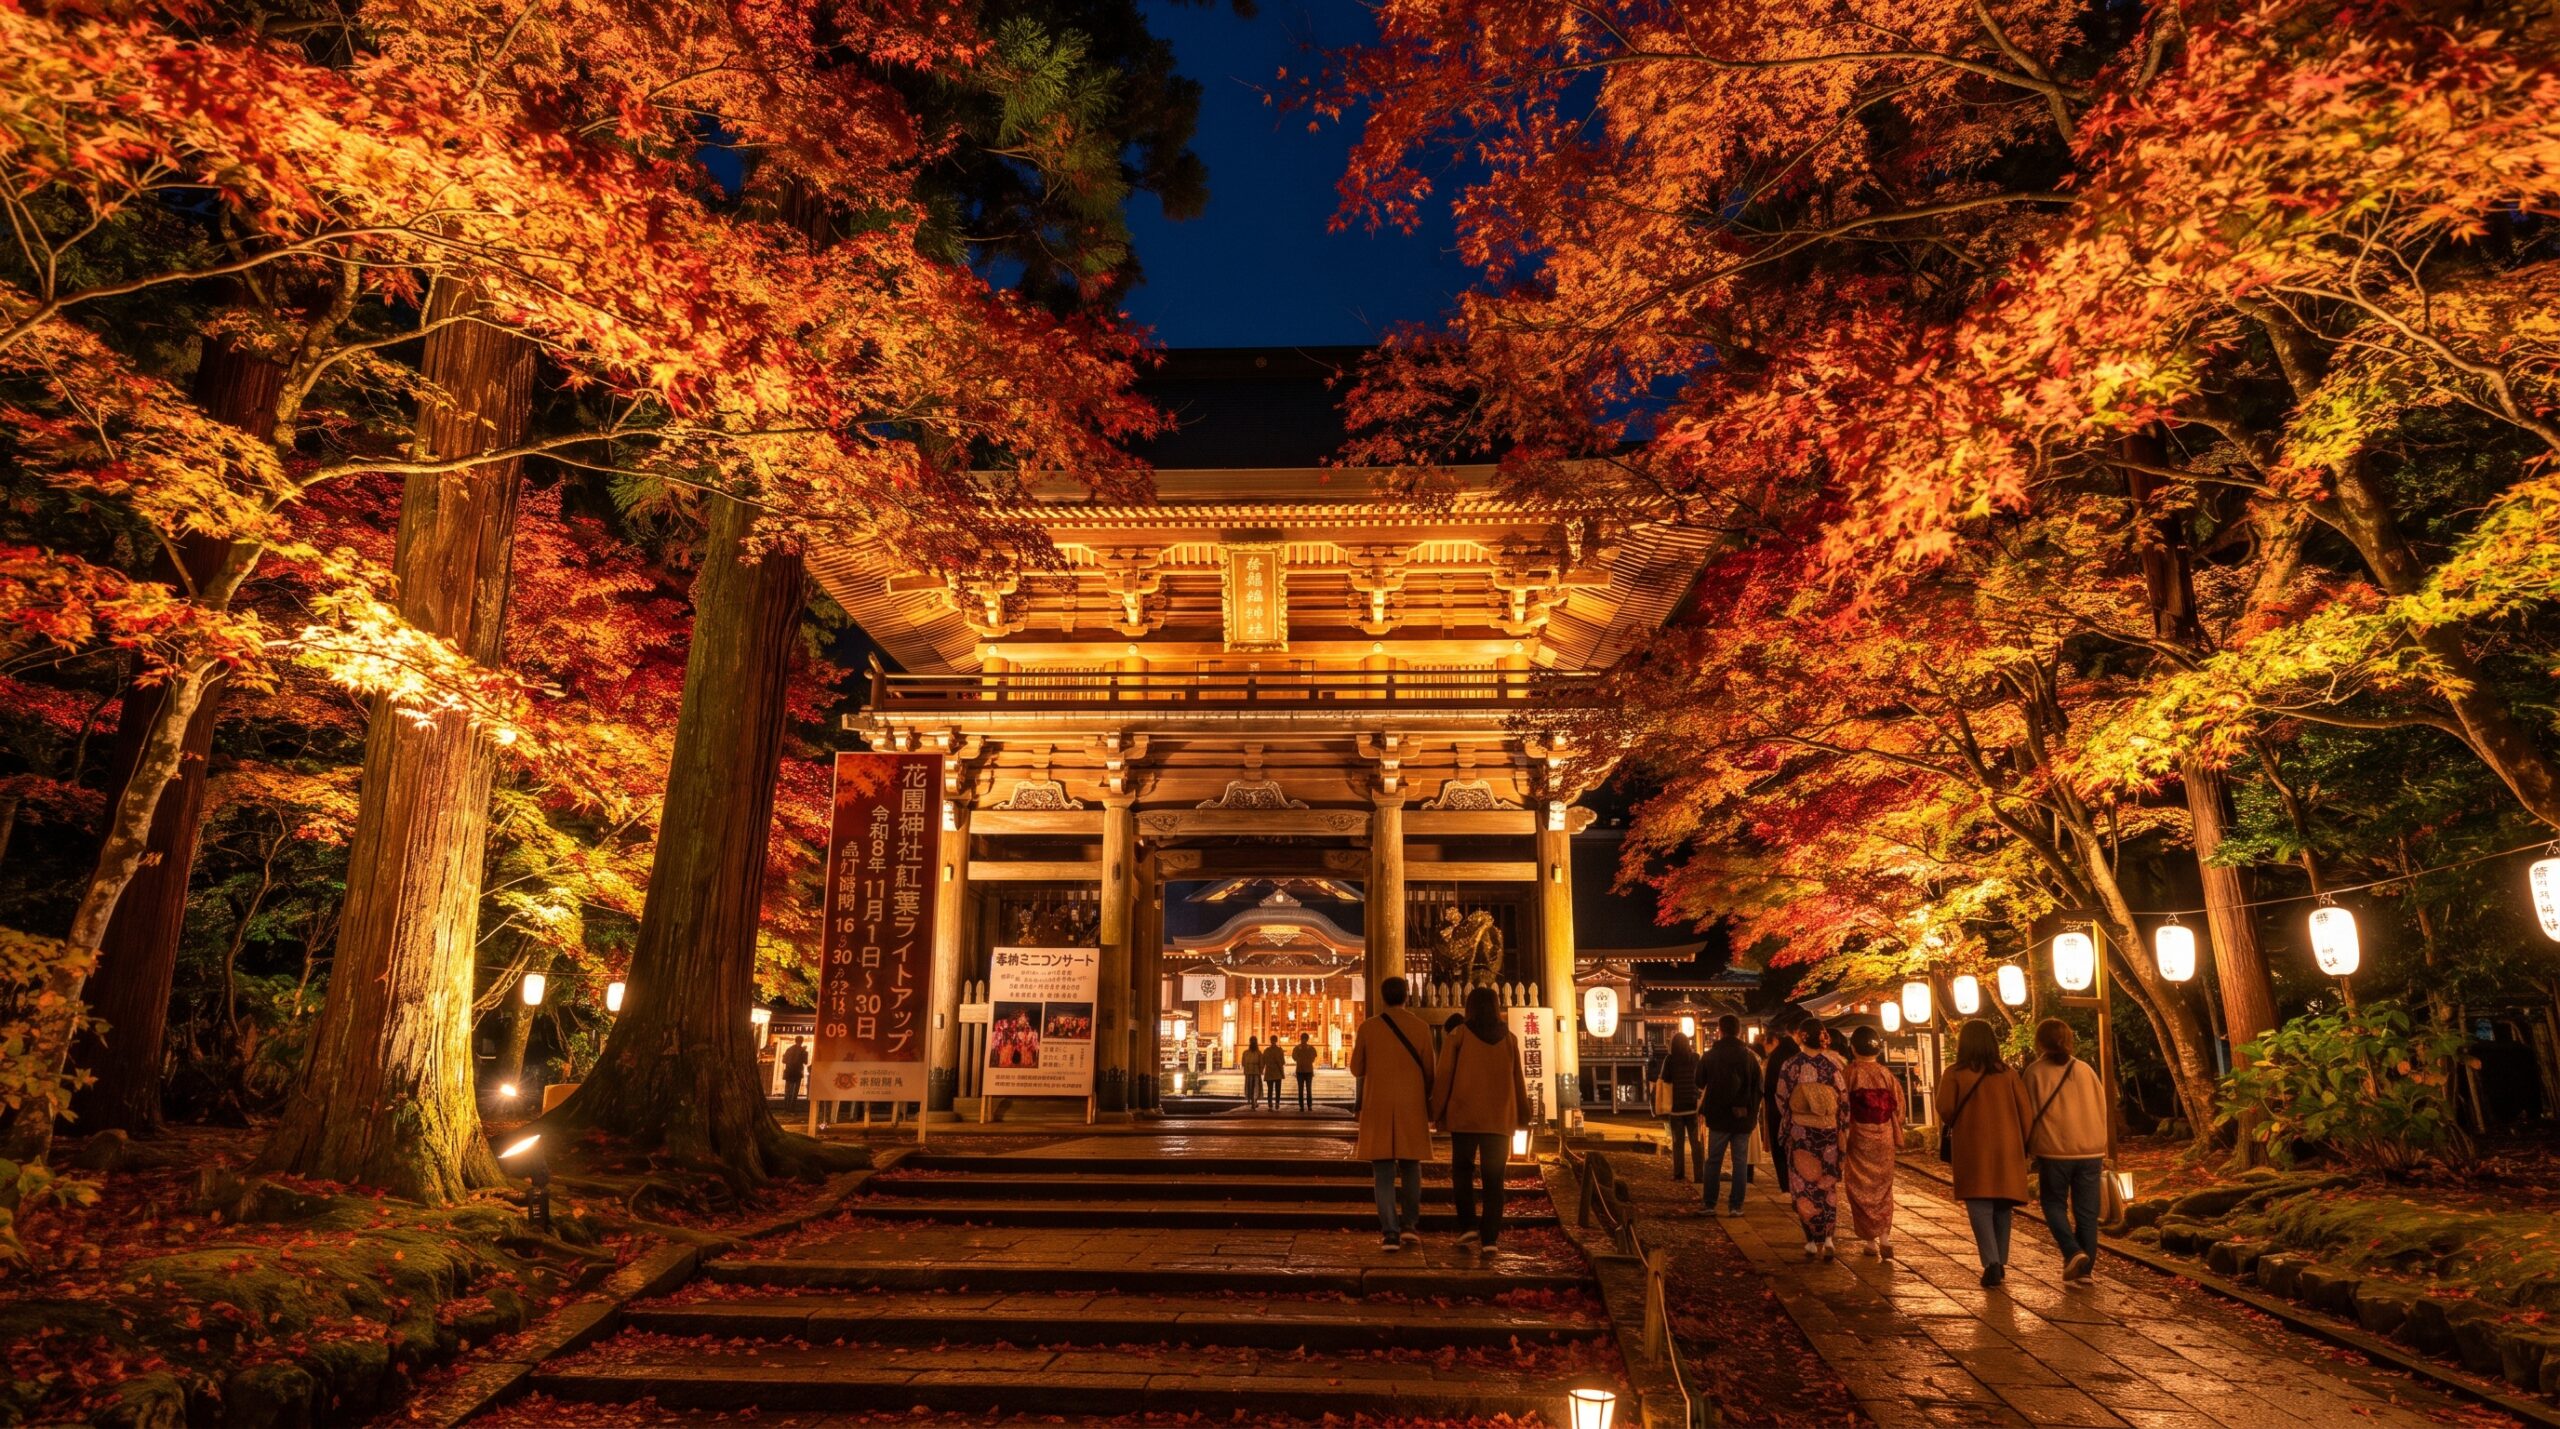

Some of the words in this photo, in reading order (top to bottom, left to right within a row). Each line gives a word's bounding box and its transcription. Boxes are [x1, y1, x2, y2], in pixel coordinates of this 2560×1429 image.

[887, 763, 928, 1053] 花園神社紅葉ライトアップ
